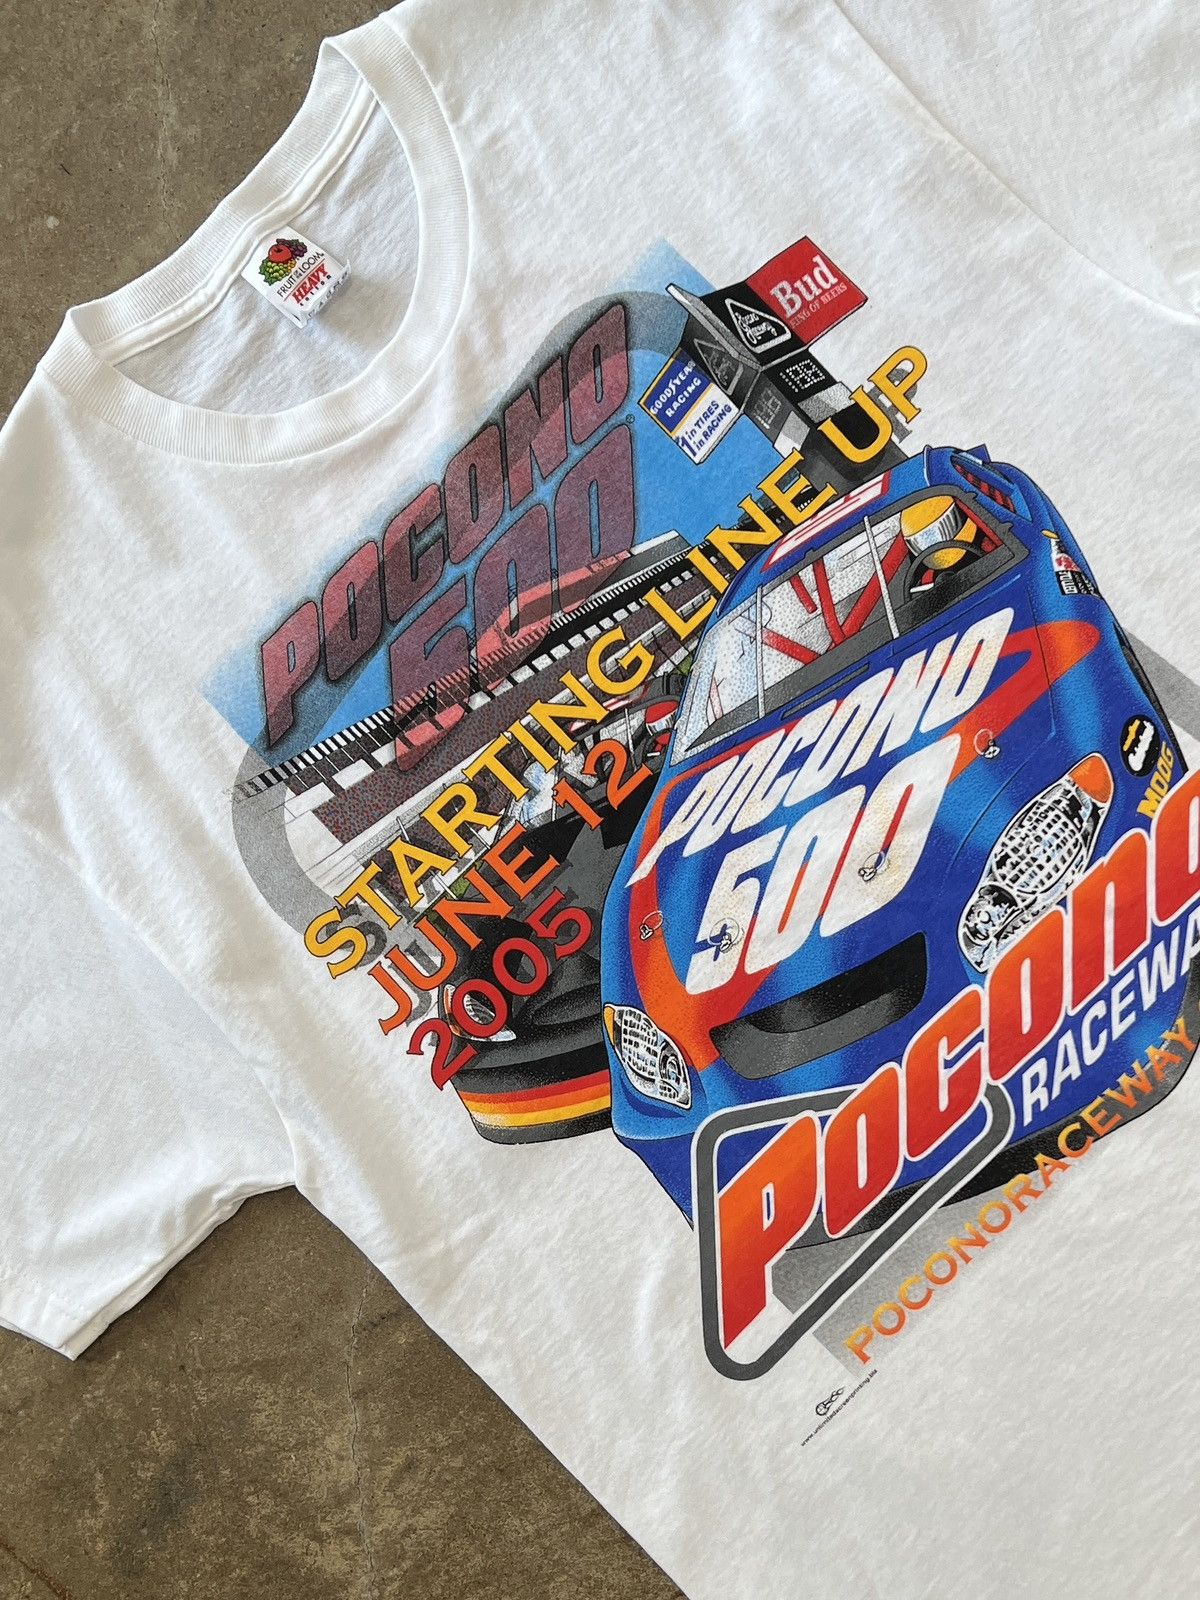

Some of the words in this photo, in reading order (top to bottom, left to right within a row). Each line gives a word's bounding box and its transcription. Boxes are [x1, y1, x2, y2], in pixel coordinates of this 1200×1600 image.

[277, 276, 297, 297] FRUIT
[300, 252, 324, 274] LOOM
[292, 263, 328, 304] HEAVY
[770, 254, 838, 318] Bud
[809, 300, 822, 314] OF
[821, 283, 848, 305] BEERS
[649, 361, 696, 415] GOODYEAR
[665, 378, 702, 418] RACING
[694, 400, 720, 430] TIRES
[702, 404, 733, 441] RACING
[261, 303, 630, 748] POCONO
[389, 423, 636, 772] 500
[304, 626, 656, 981] STARTING
[642, 448, 837, 638] LINE
[817, 346, 932, 467] UP
[624, 607, 1015, 888] POCONO
[1137, 741, 1174, 819] MOOG
[367, 827, 560, 1034] JUNE
[553, 736, 655, 834] 12
[686, 733, 962, 996] 500
[406, 887, 593, 1089] 2005
